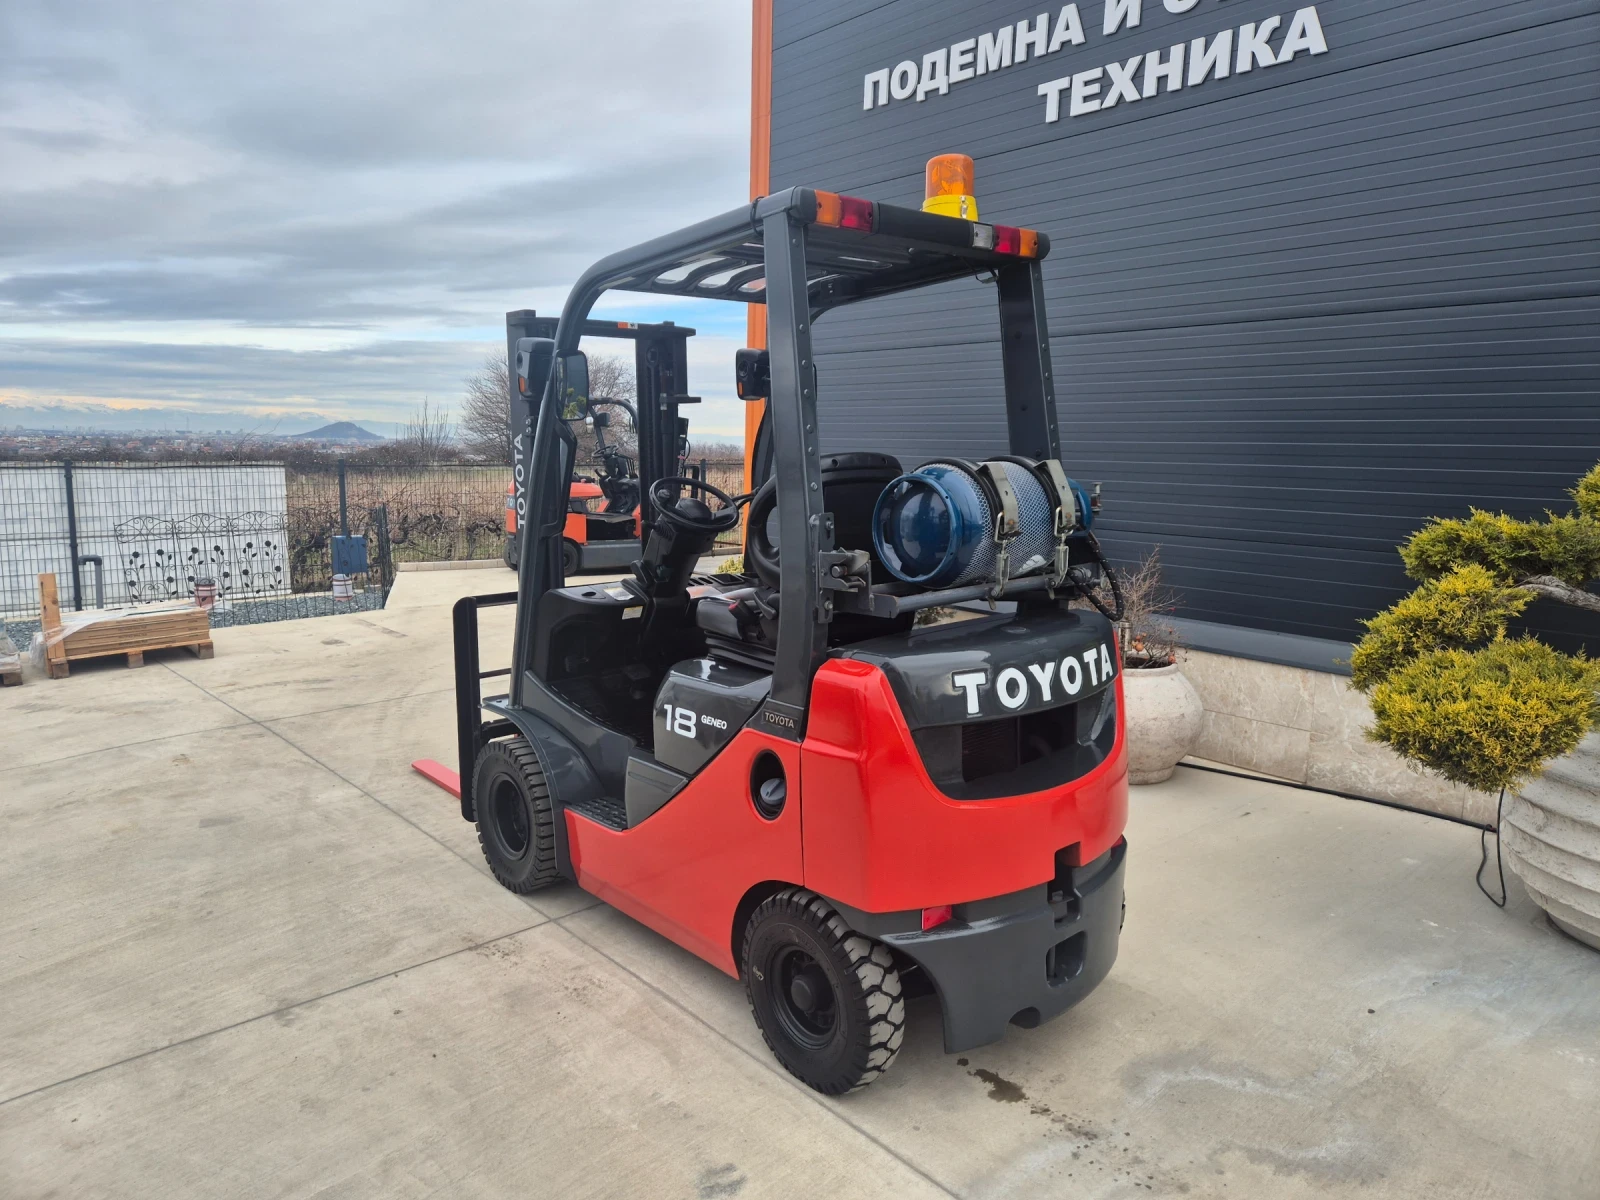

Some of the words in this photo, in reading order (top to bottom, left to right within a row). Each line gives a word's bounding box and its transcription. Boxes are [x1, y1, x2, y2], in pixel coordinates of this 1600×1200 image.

[863, 3, 1086, 110] ПОДЕМНА
[1037, 5, 1328, 123] ТЕХНИКА
[514, 433, 526, 529] TOYOTA
[764, 712, 795, 729] TOYOTA
[953, 643, 1114, 715] TOYOTA
[663, 704, 697, 739] 18
[701, 714, 728, 730] GENEO
